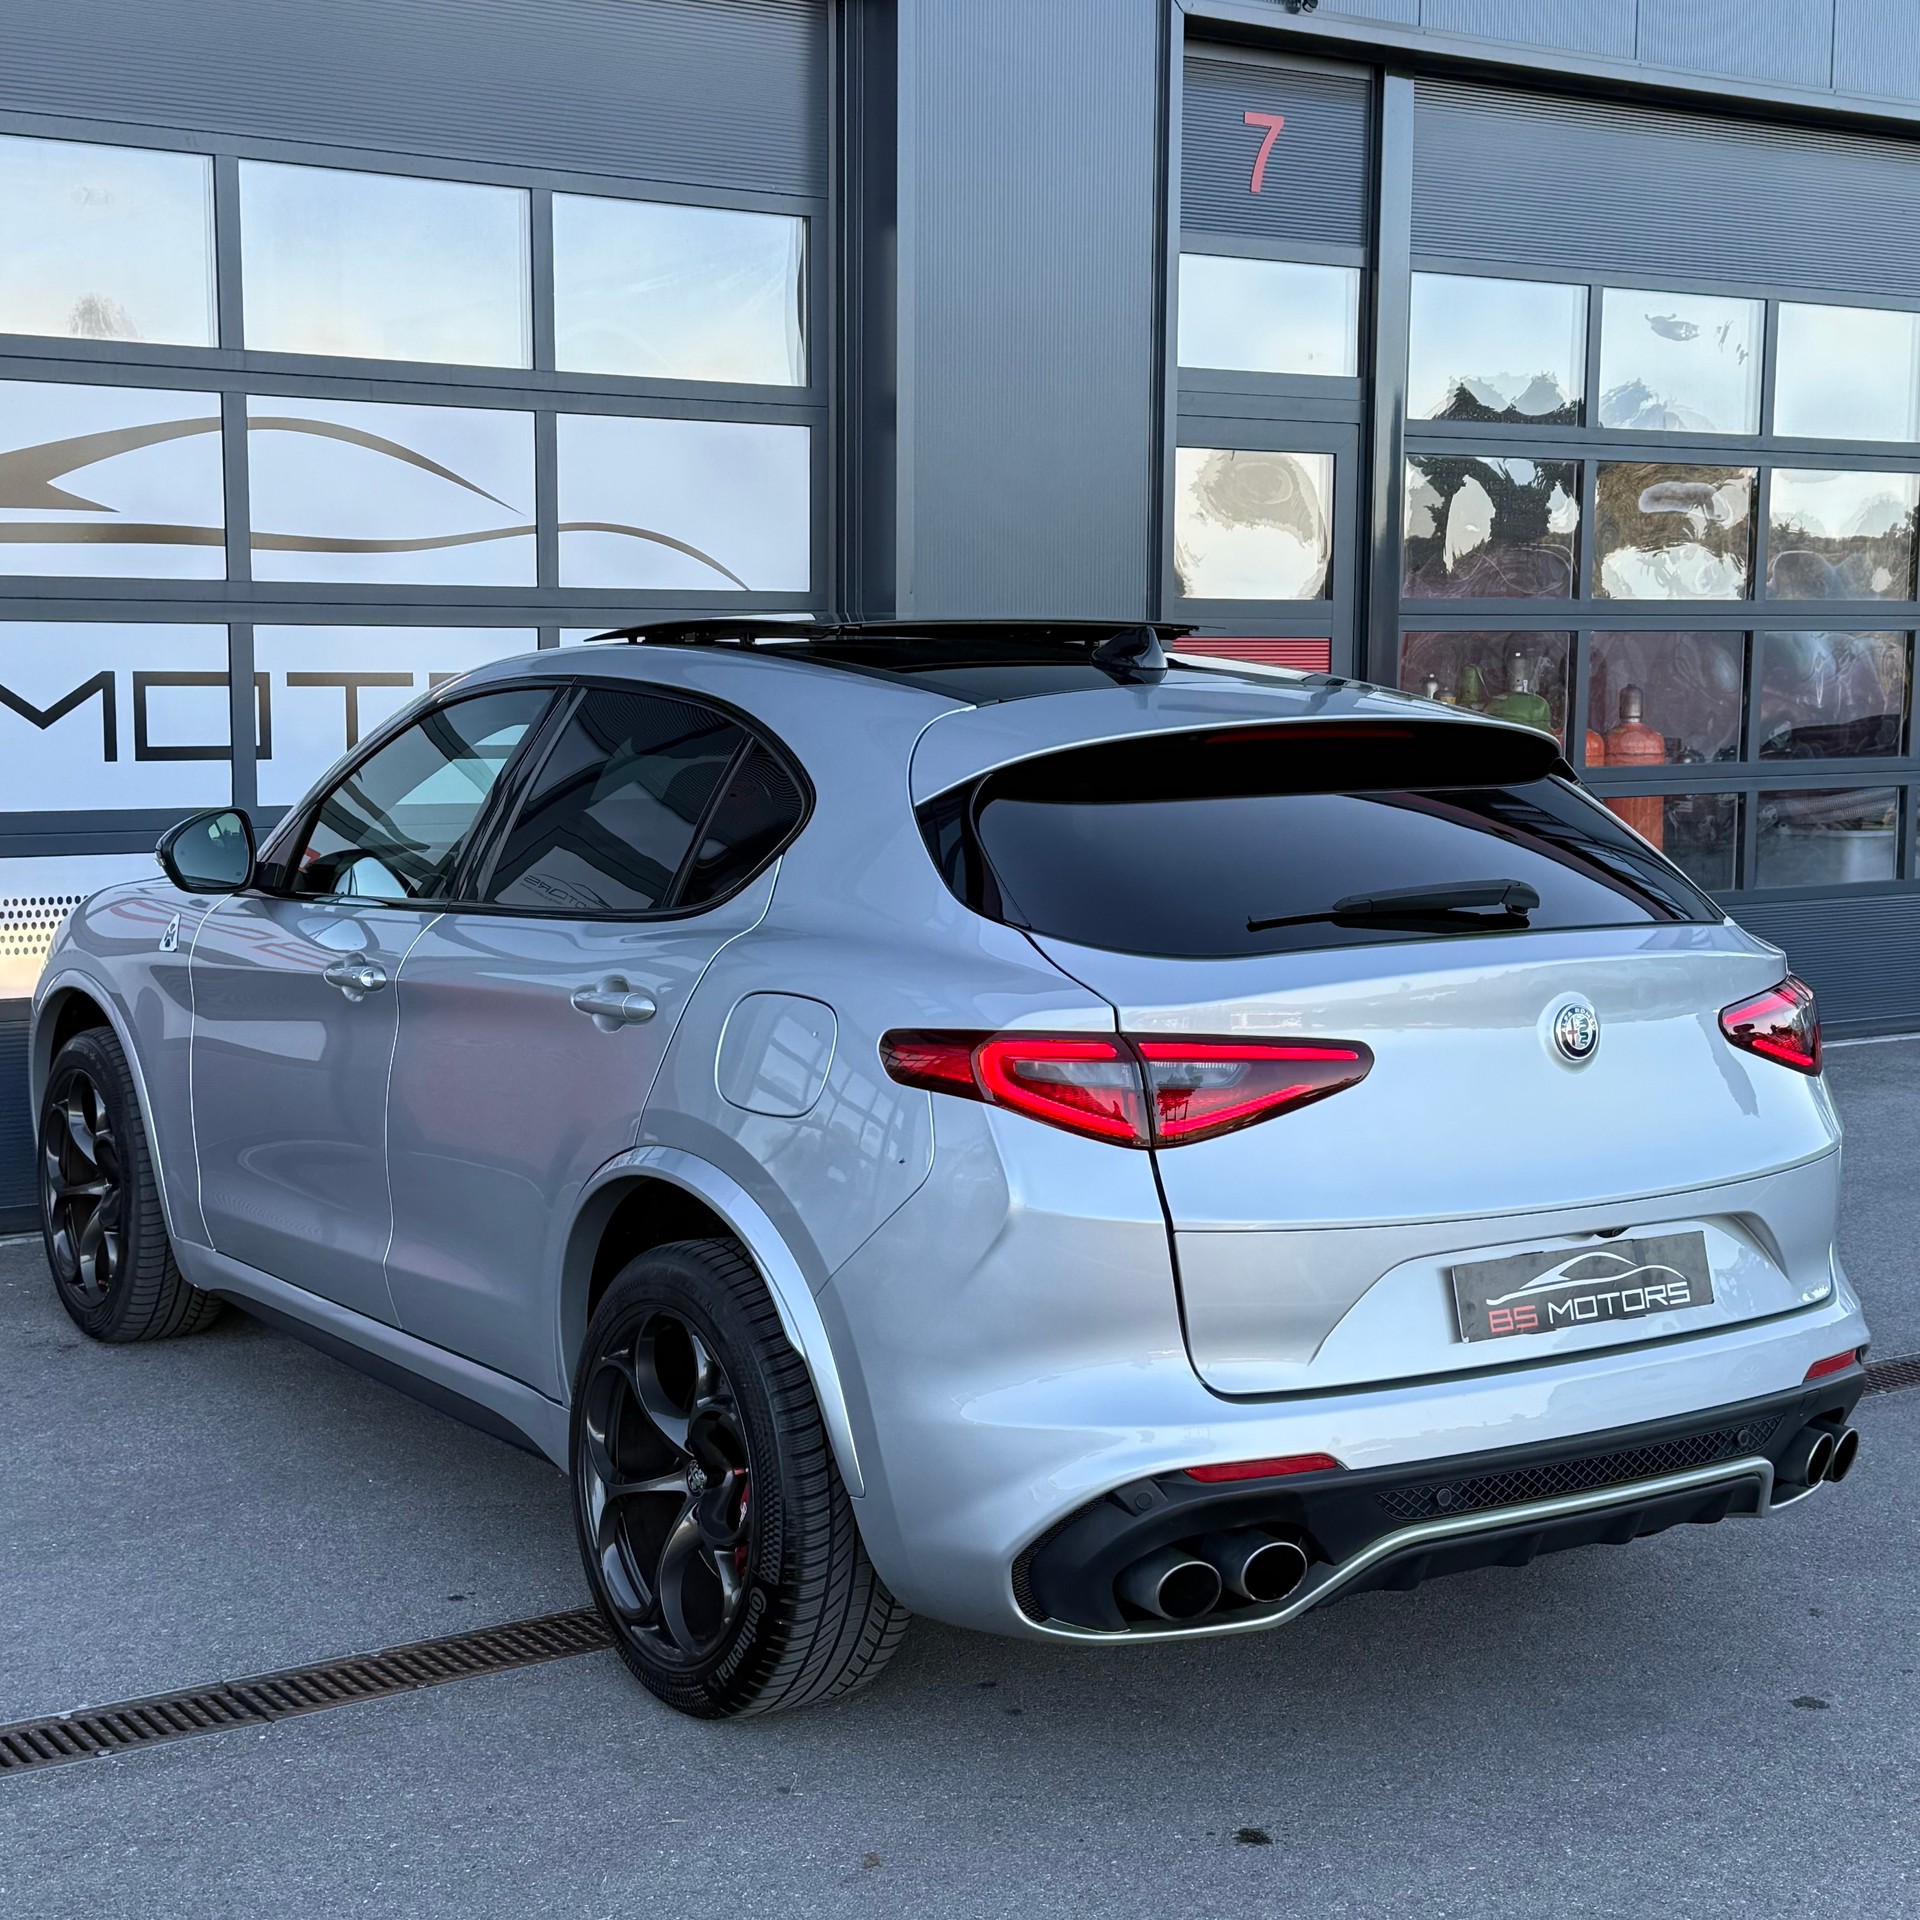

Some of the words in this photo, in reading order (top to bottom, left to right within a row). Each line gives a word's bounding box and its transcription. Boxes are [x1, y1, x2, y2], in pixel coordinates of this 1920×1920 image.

[1243, 111, 1285, 193] 7
[0, 671, 467, 762] MOT
[1547, 1281, 1691, 1325] MOTORS
[716, 1586, 767, 1688] Continental
